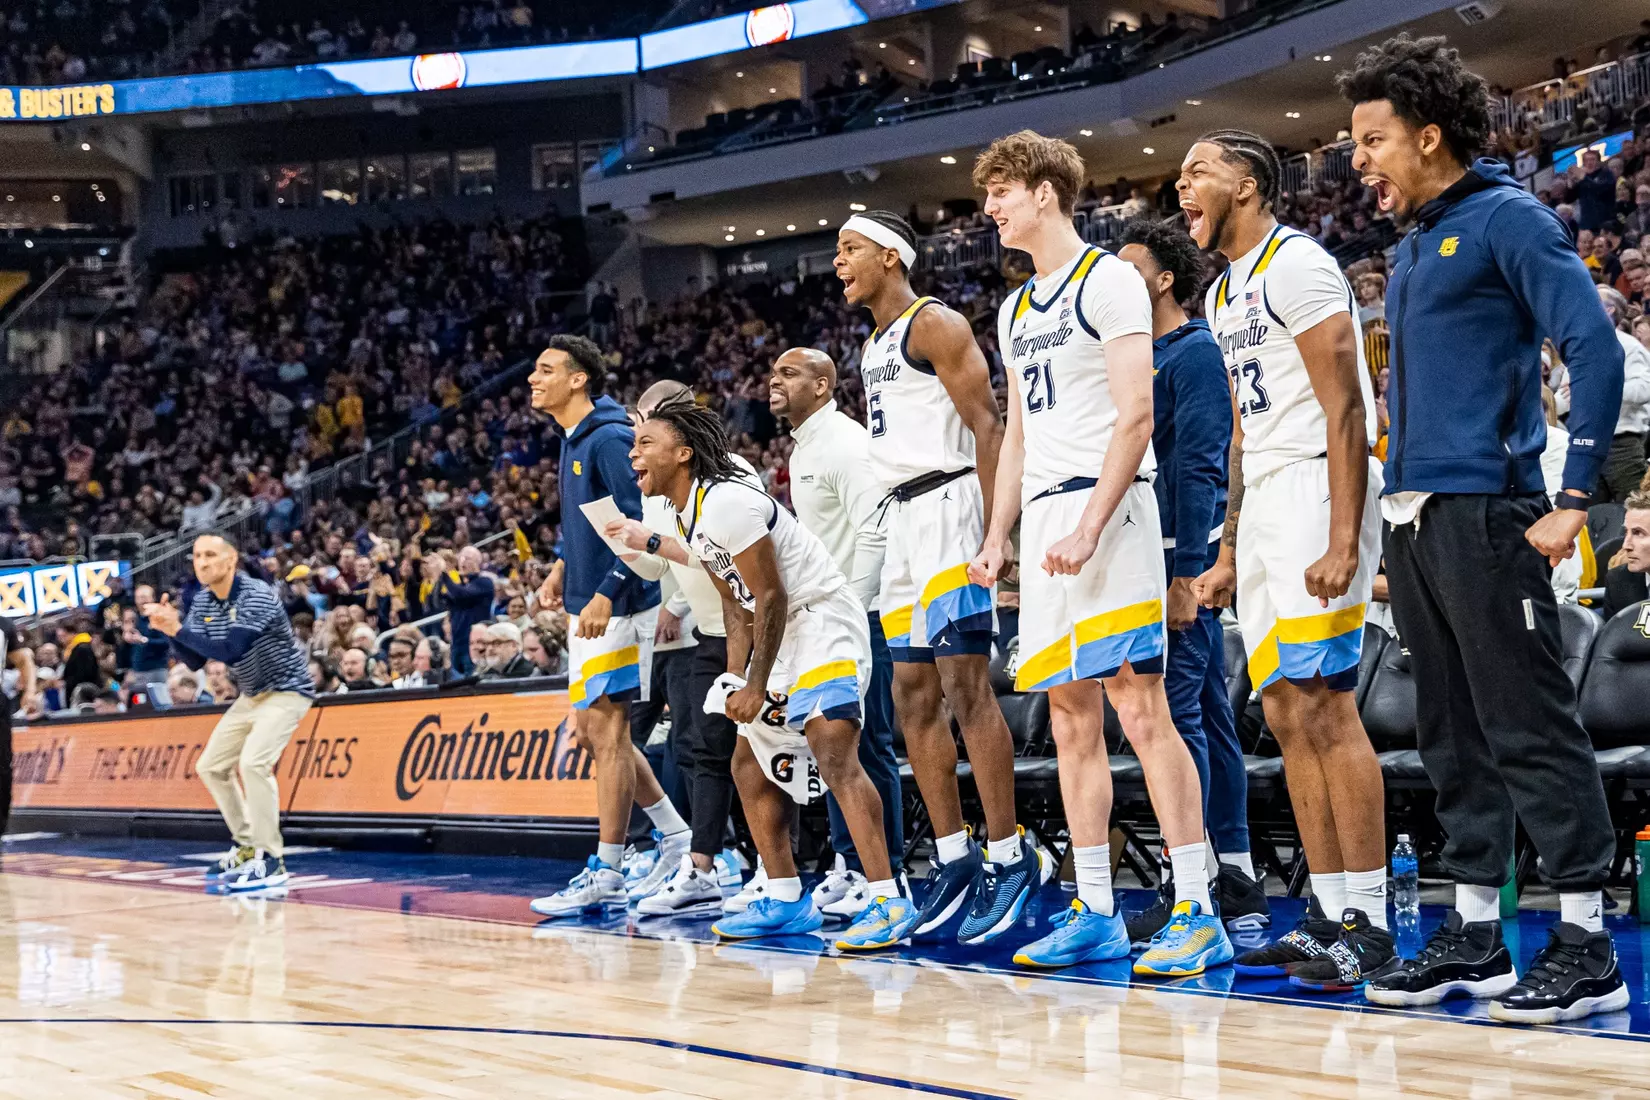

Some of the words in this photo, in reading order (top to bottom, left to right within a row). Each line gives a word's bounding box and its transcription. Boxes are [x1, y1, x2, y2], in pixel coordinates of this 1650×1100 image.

[20, 84, 115, 118] BUSTER'S
[1012, 321, 1073, 361] Marquette
[1023, 359, 1056, 414] 21
[869, 391, 887, 438] 5
[288, 737, 359, 779] TIRES
